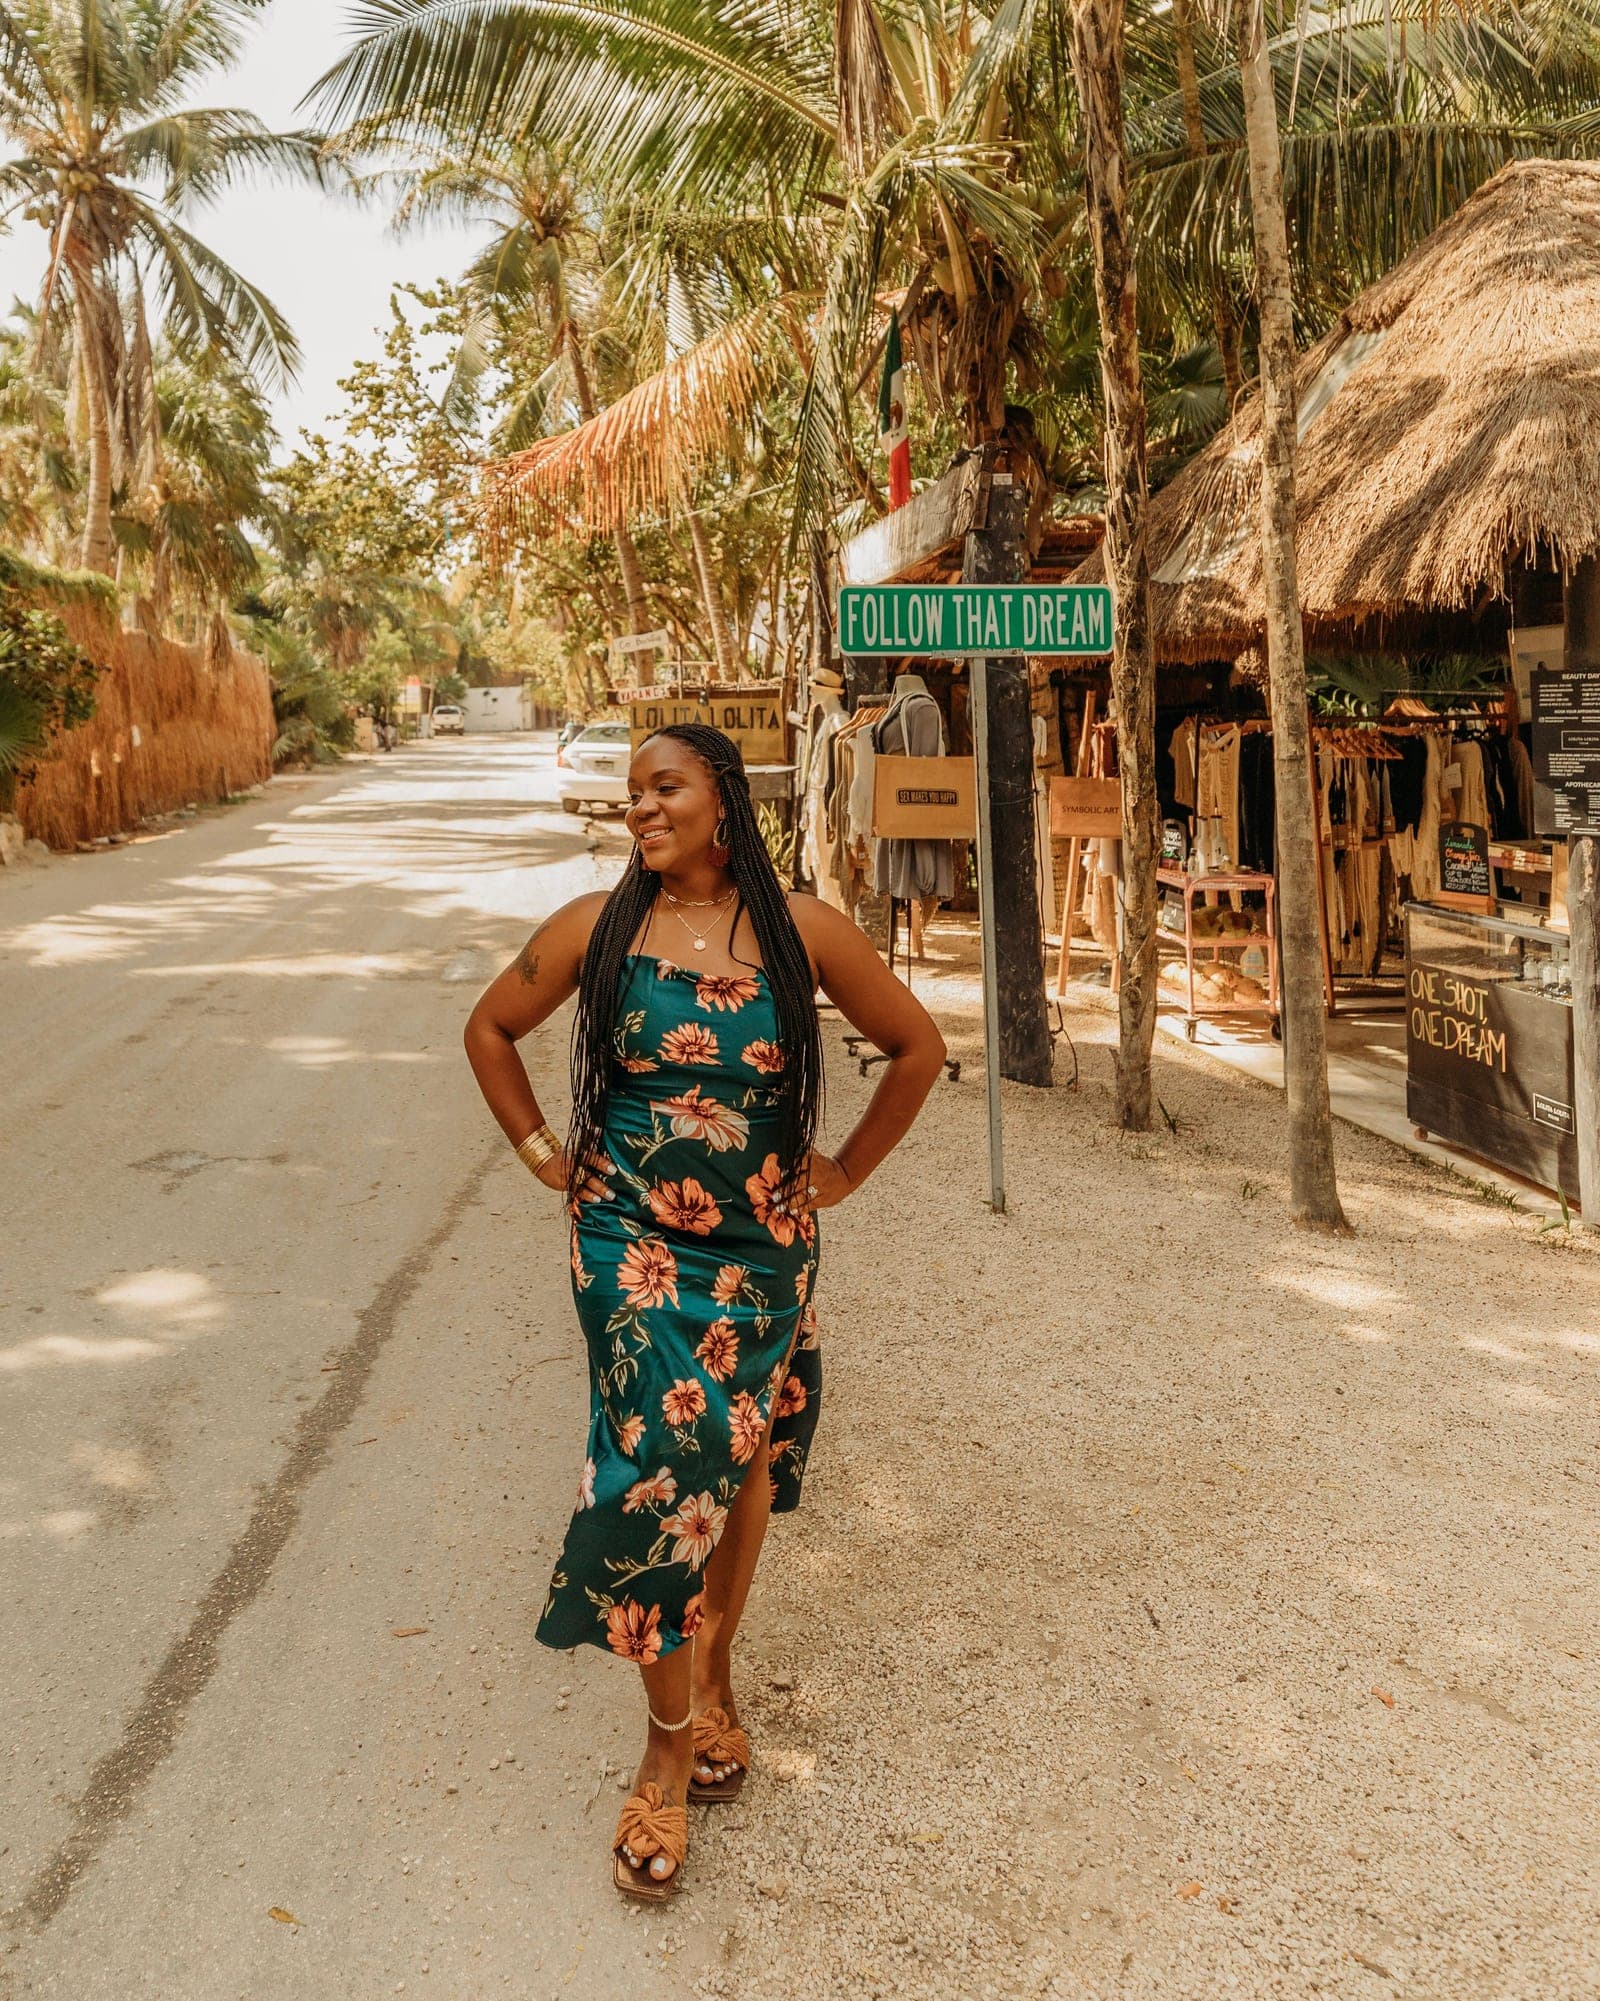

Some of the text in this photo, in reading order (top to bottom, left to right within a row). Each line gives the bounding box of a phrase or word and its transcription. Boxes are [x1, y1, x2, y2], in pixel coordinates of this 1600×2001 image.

[847, 593, 1105, 647] FOLLOW THAT DREAM
[710, 706, 780, 729] LOLITA
[1062, 805, 1120, 814] SYMBOLIC ART
[1410, 968, 1441, 1005] ONE
[1411, 1007, 1506, 1073] ONE DREAM
